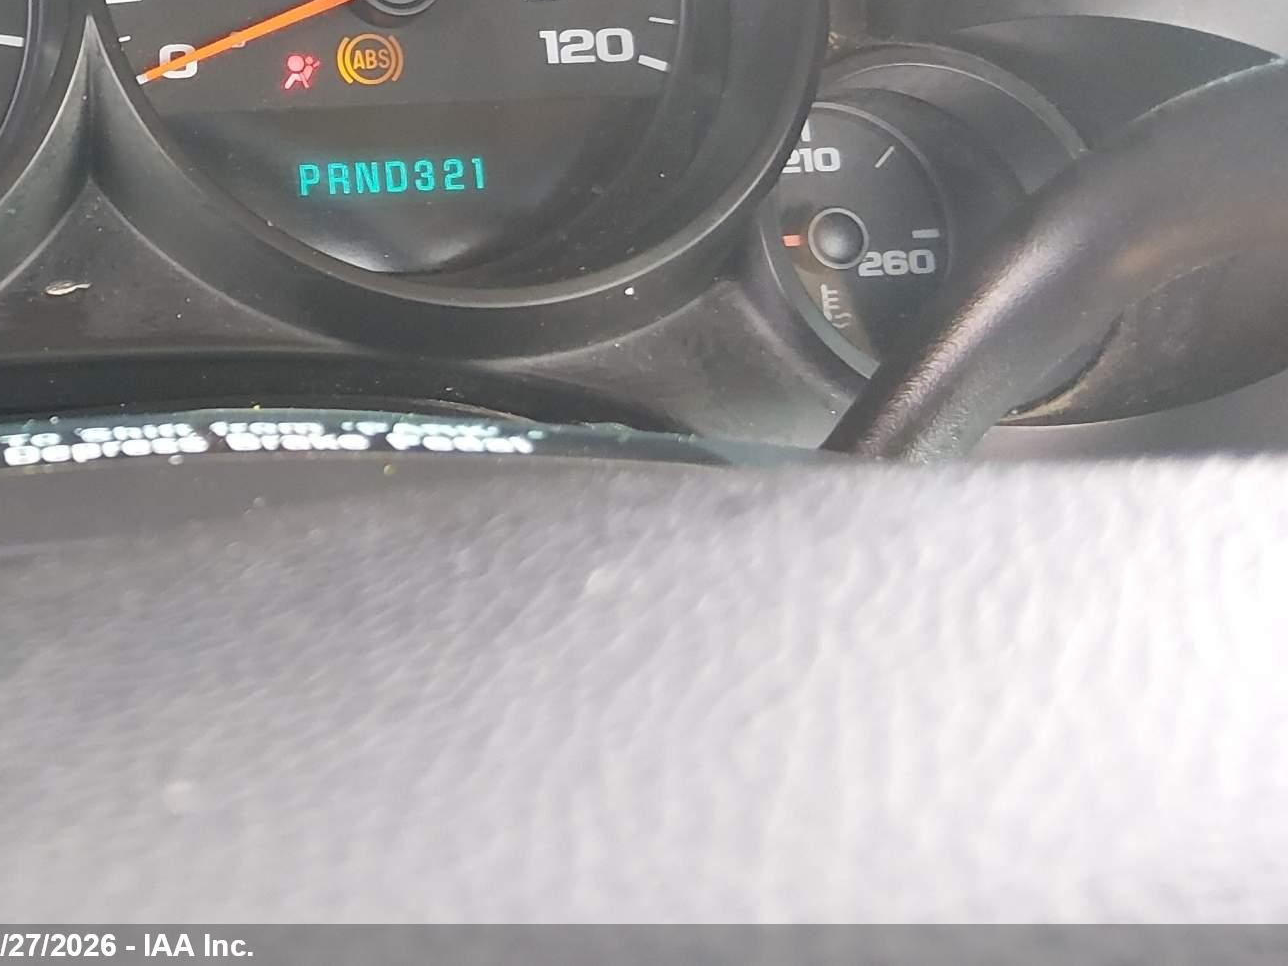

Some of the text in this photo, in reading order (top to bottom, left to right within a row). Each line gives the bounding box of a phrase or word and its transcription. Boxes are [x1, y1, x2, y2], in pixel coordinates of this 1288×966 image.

[159, 43, 198, 79] 0
[353, 48, 391, 70] ABS
[539, 27, 635, 64] 120
[858, 248, 935, 277] 260
